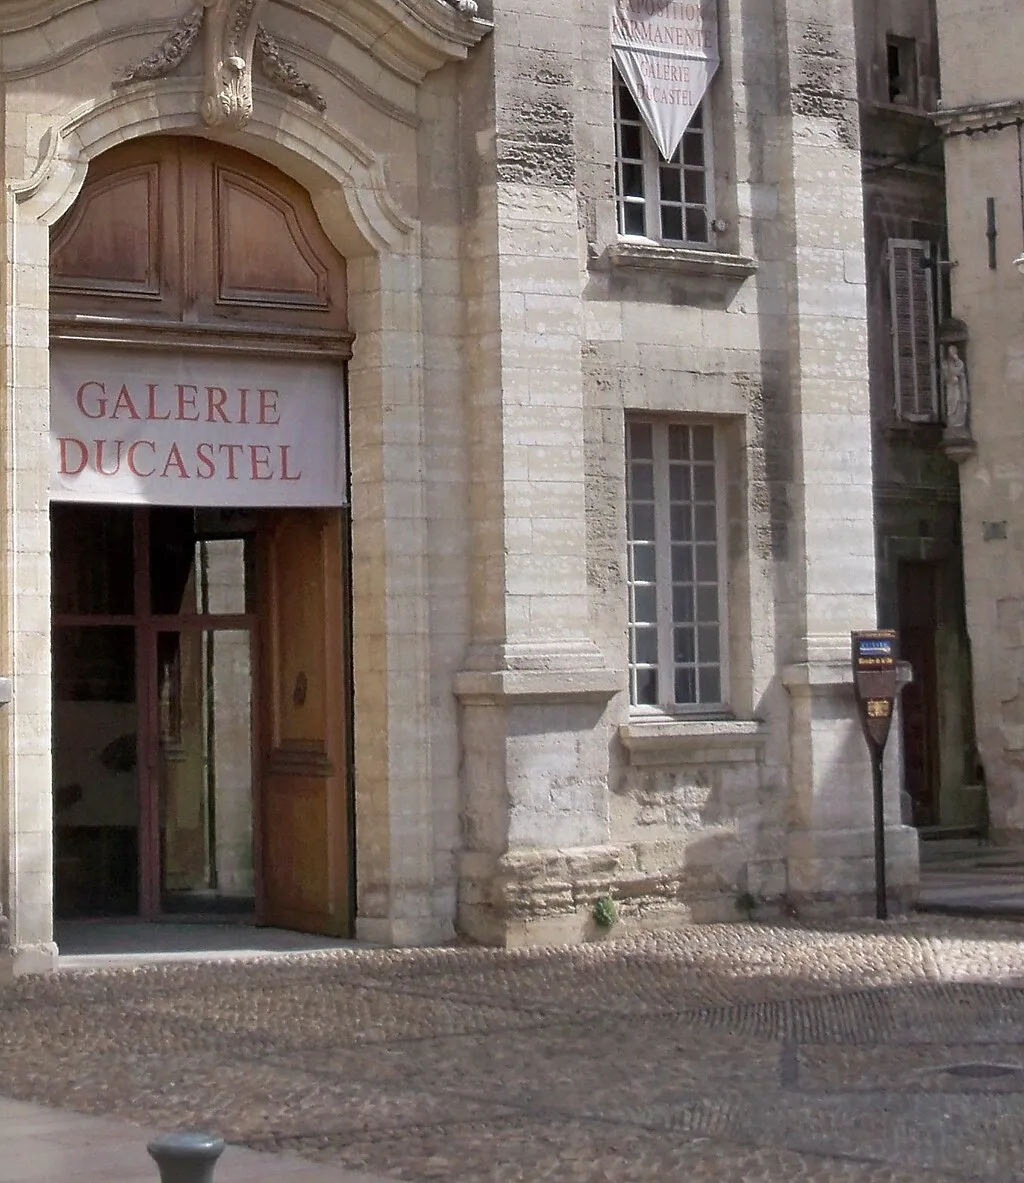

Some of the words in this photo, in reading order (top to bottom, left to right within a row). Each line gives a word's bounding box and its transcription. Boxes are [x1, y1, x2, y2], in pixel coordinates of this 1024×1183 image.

[640, 60, 690, 83] GALERIE
[636, 83, 696, 107] DUCASTEL
[76, 381, 281, 425] GALERIE
[56, 437, 303, 481] DUCASTEL
